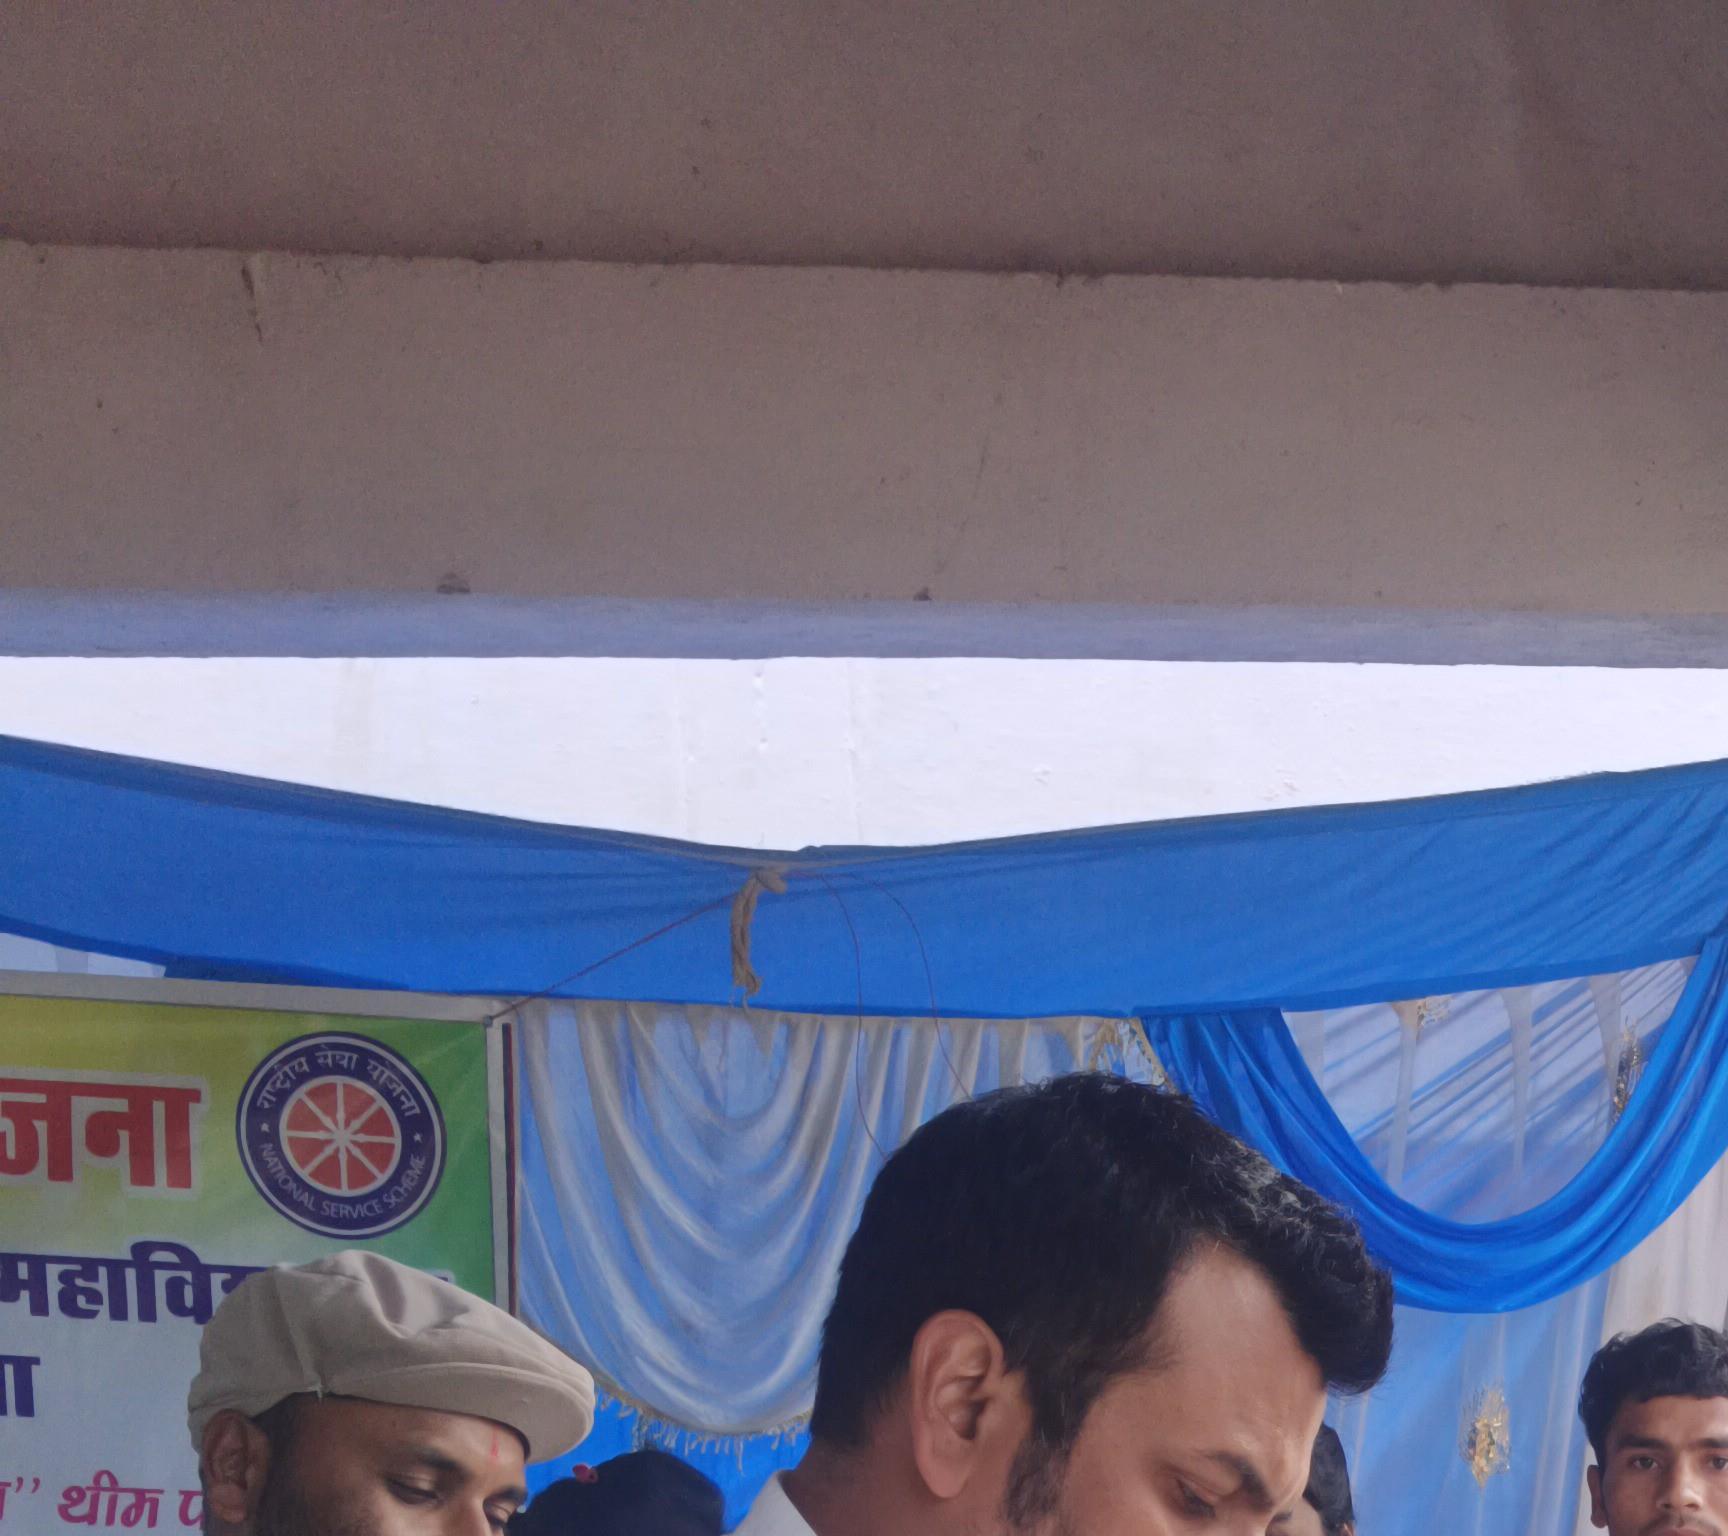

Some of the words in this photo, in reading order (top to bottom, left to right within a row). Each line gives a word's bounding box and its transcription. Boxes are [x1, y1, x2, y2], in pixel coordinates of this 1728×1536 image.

[260, 1142, 316, 1212] NATIONAL
[320, 1200, 384, 1219] SERVICE
[383, 1153, 427, 1209] SCHEME
[57, 1469, 165, 1529] थीम
